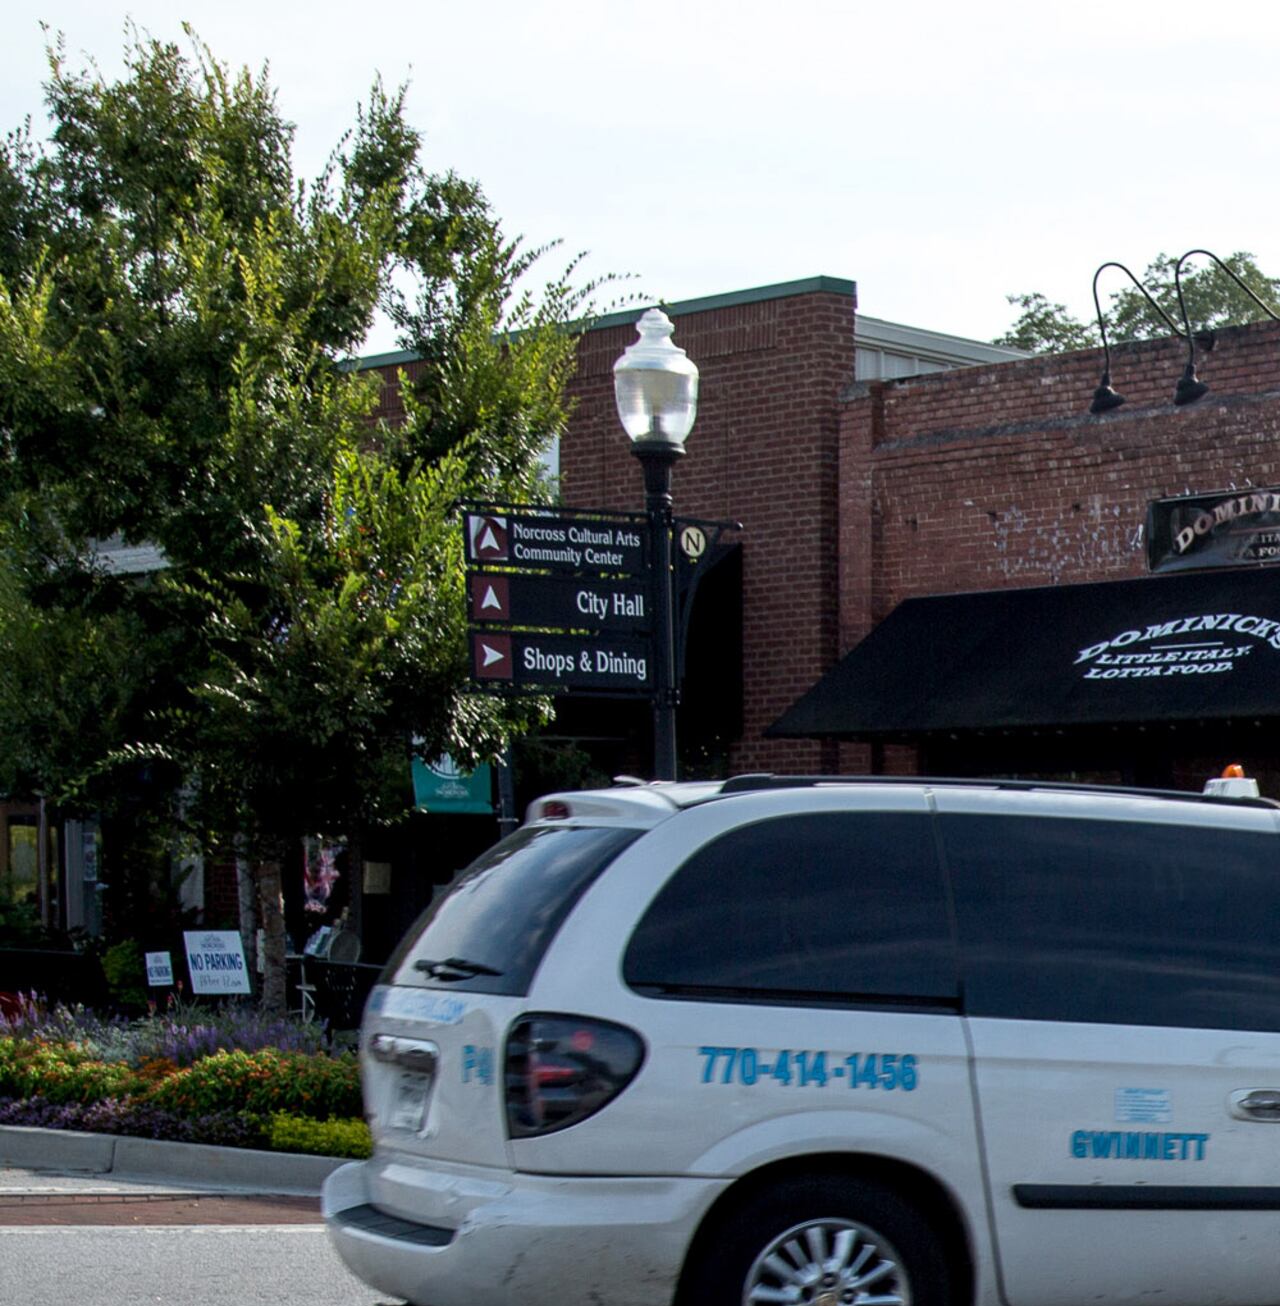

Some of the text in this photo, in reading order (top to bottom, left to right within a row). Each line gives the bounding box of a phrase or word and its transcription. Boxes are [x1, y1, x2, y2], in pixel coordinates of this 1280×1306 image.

[513, 523, 641, 547] Norcross Cultural Arts
[686, 532, 701, 553] N
[514, 544, 623, 567] Community Center
[576, 590, 645, 619] City Hall
[523, 647, 647, 681] Shops & Dining
[1096, 645, 1253, 665] LITTLE ITALY.
[1083, 666, 1163, 679] LOTTA
[190, 953, 243, 971] NO PARKING
[698, 1046, 918, 1091] 770-414-1456
[1071, 1130, 1211, 1161] GWINNETT
